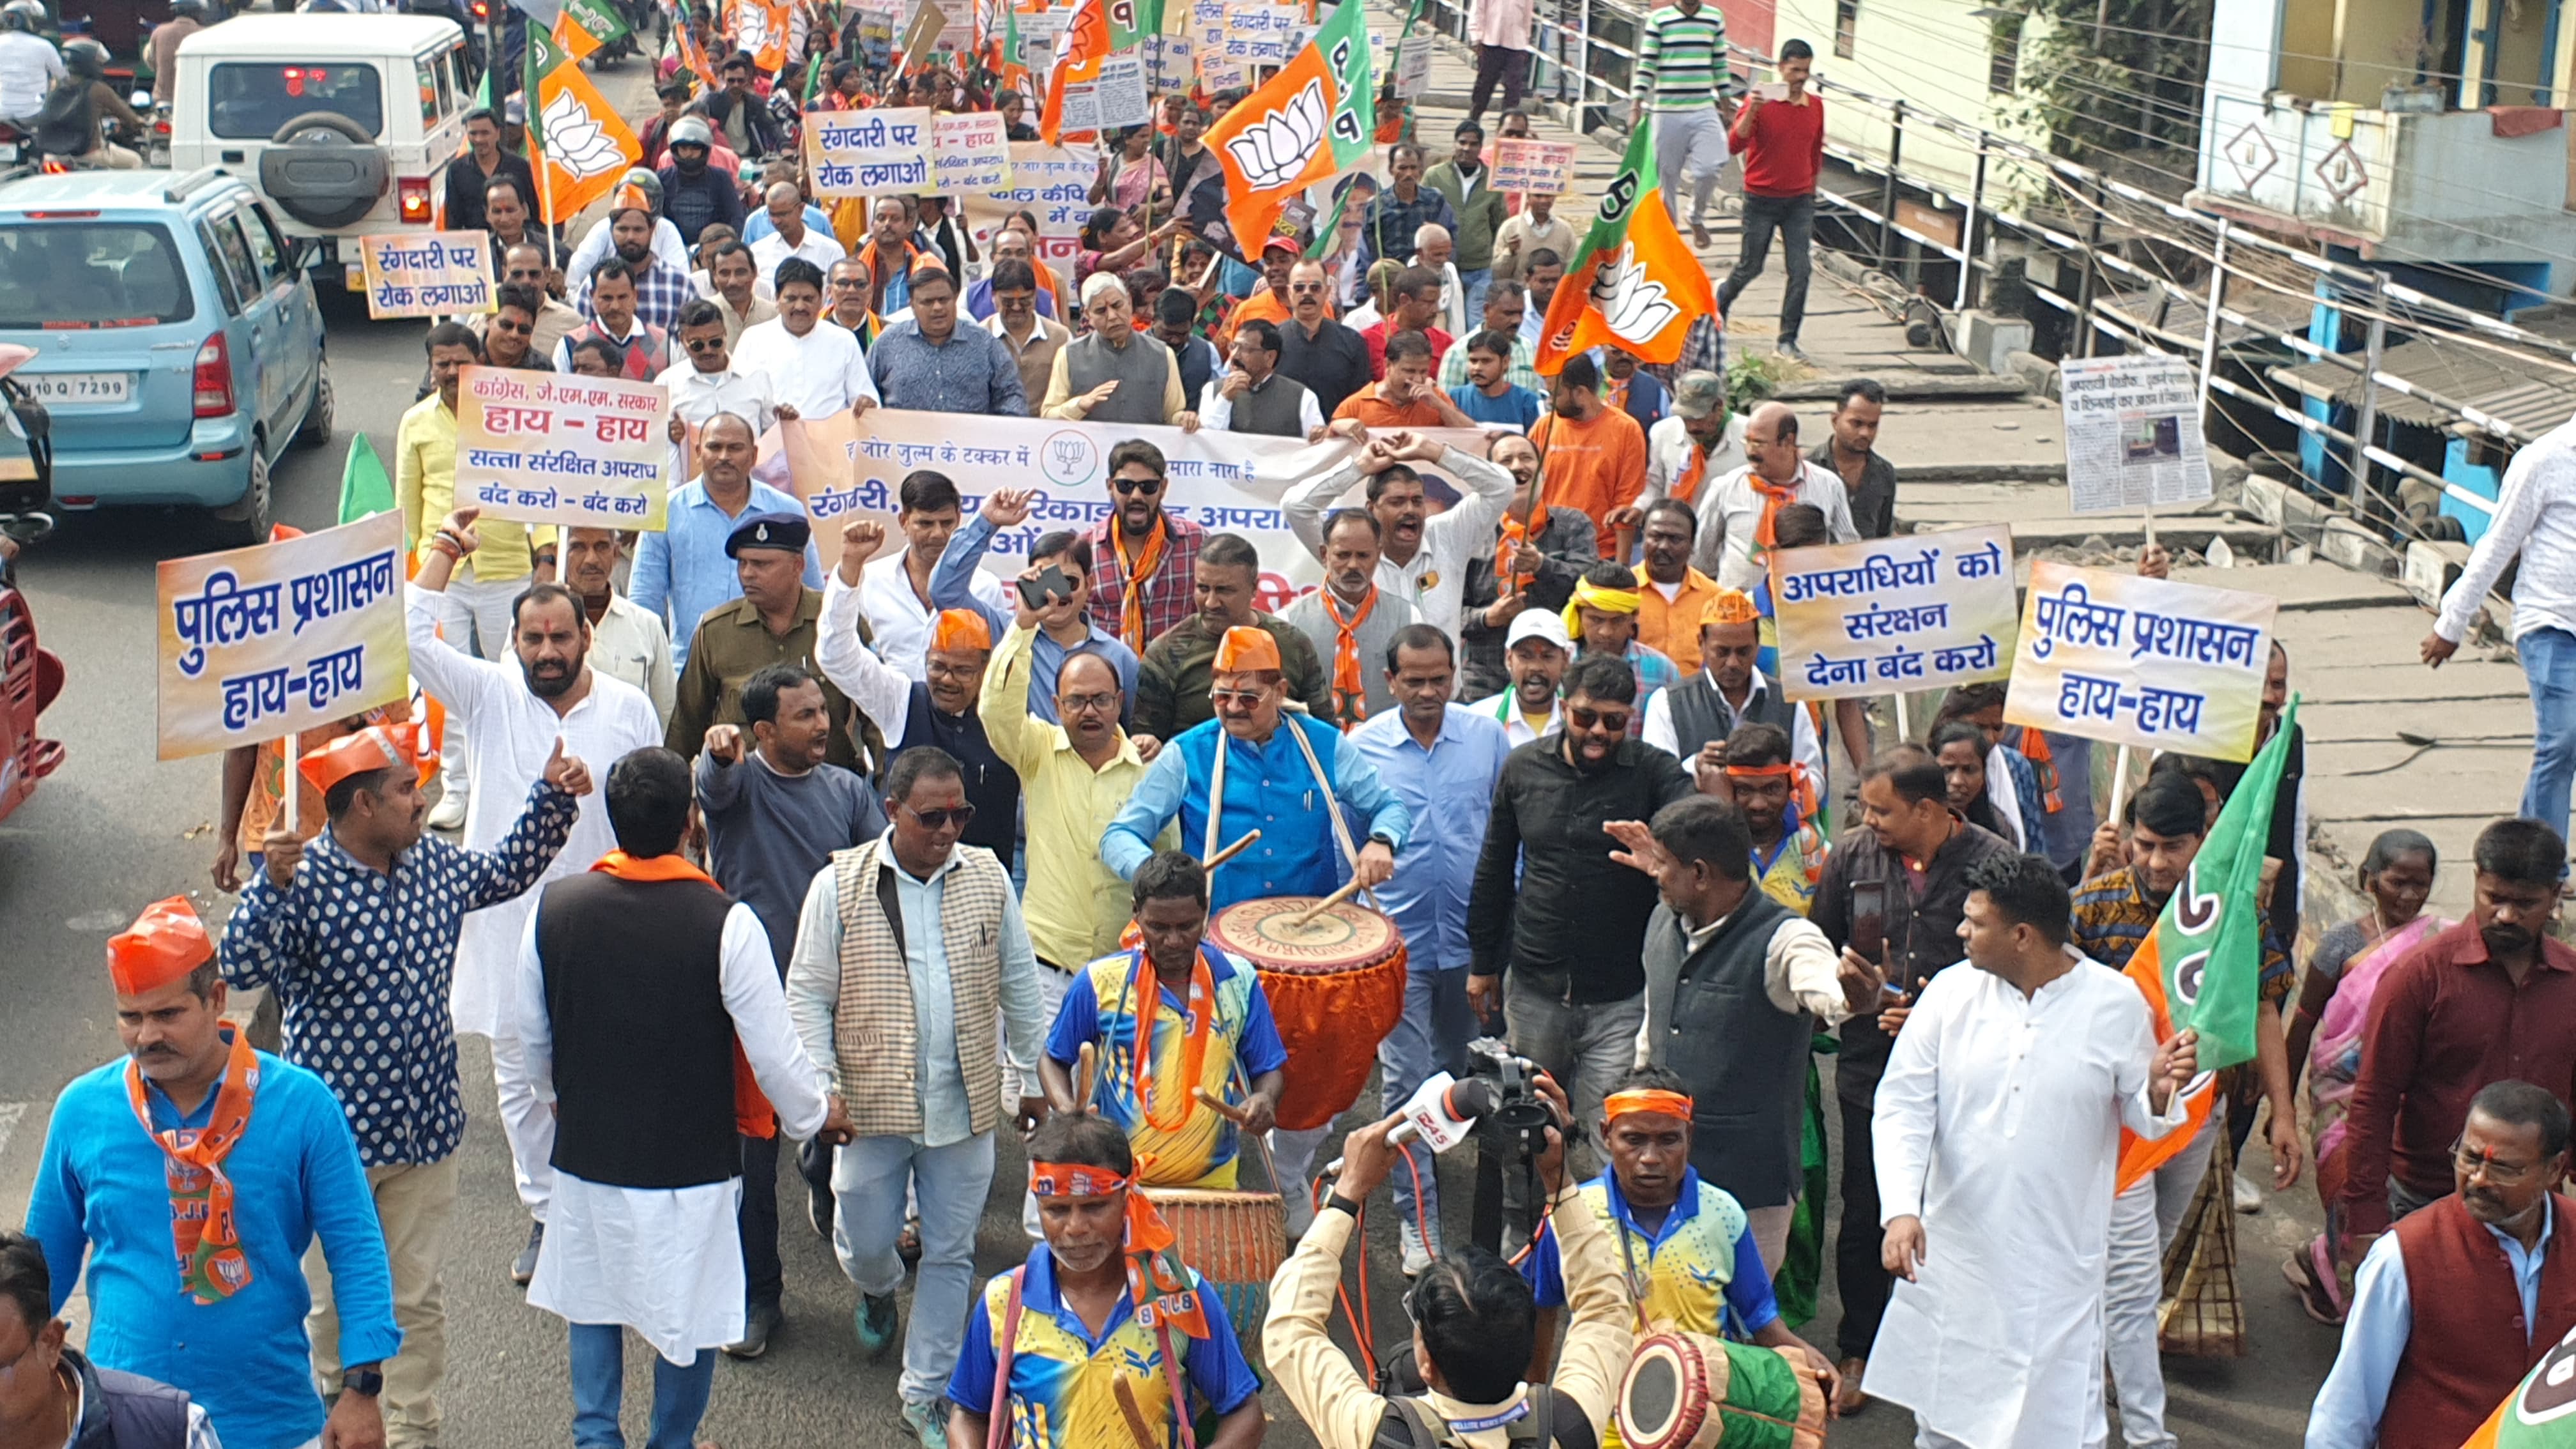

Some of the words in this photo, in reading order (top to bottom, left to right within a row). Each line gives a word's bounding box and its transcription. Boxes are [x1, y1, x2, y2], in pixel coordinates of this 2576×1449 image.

[1231, 8, 1269, 31] रंगदारी
[1226, 34, 1248, 55] रोक
[820, 117, 885, 150] रंगदारी
[891, 125, 917, 146] पर
[965, 132, 997, 149] हाय
[817, 158, 854, 187] रोक
[861, 154, 926, 186] लगाओ
[1048, 206, 1071, 223] में
[378, 241, 444, 271] रंगदारी
[450, 248, 476, 268] पर
[376, 280, 414, 307] रोक
[419, 276, 487, 307] लगाओ
[474, 377, 529, 401] कांग्रेस,
[618, 394, 657, 412] सरकार
[484, 406, 553, 434] हाय
[595, 415, 649, 442] हाय
[469, 449, 521, 469] सत्ता
[528, 450, 597, 475] संरक्षित
[602, 461, 657, 479] अपराध
[861, 436, 891, 458] जोर
[897, 443, 935, 466] जुल्म
[940, 441, 958, 462] के
[963, 448, 1011, 465] टक्कर
[1016, 445, 1030, 466] में
[1166, 461, 1203, 476] मारा
[1209, 462, 1239, 479] नारा
[480, 482, 509, 504] बंद
[518, 486, 558, 509] करो
[583, 491, 610, 511] बंद
[615, 494, 647, 515] करो
[1198, 506, 1292, 529] अपरा
[1783, 548, 1940, 601] अपराधियों
[1956, 541, 2000, 577] को
[174, 572, 282, 674] पुलिस
[291, 549, 395, 634] प्रशासन
[1844, 602, 1948, 639] संरक्षन
[2034, 583, 2126, 659] पुलिस
[2131, 611, 2260, 667] प्रशासन
[1805, 653, 1866, 686] देना
[1875, 645, 1924, 679] बंद
[1933, 634, 1995, 671] करो
[222, 646, 364, 730] हाय-हाय
[2058, 672, 2204, 733] हाय-हाय
